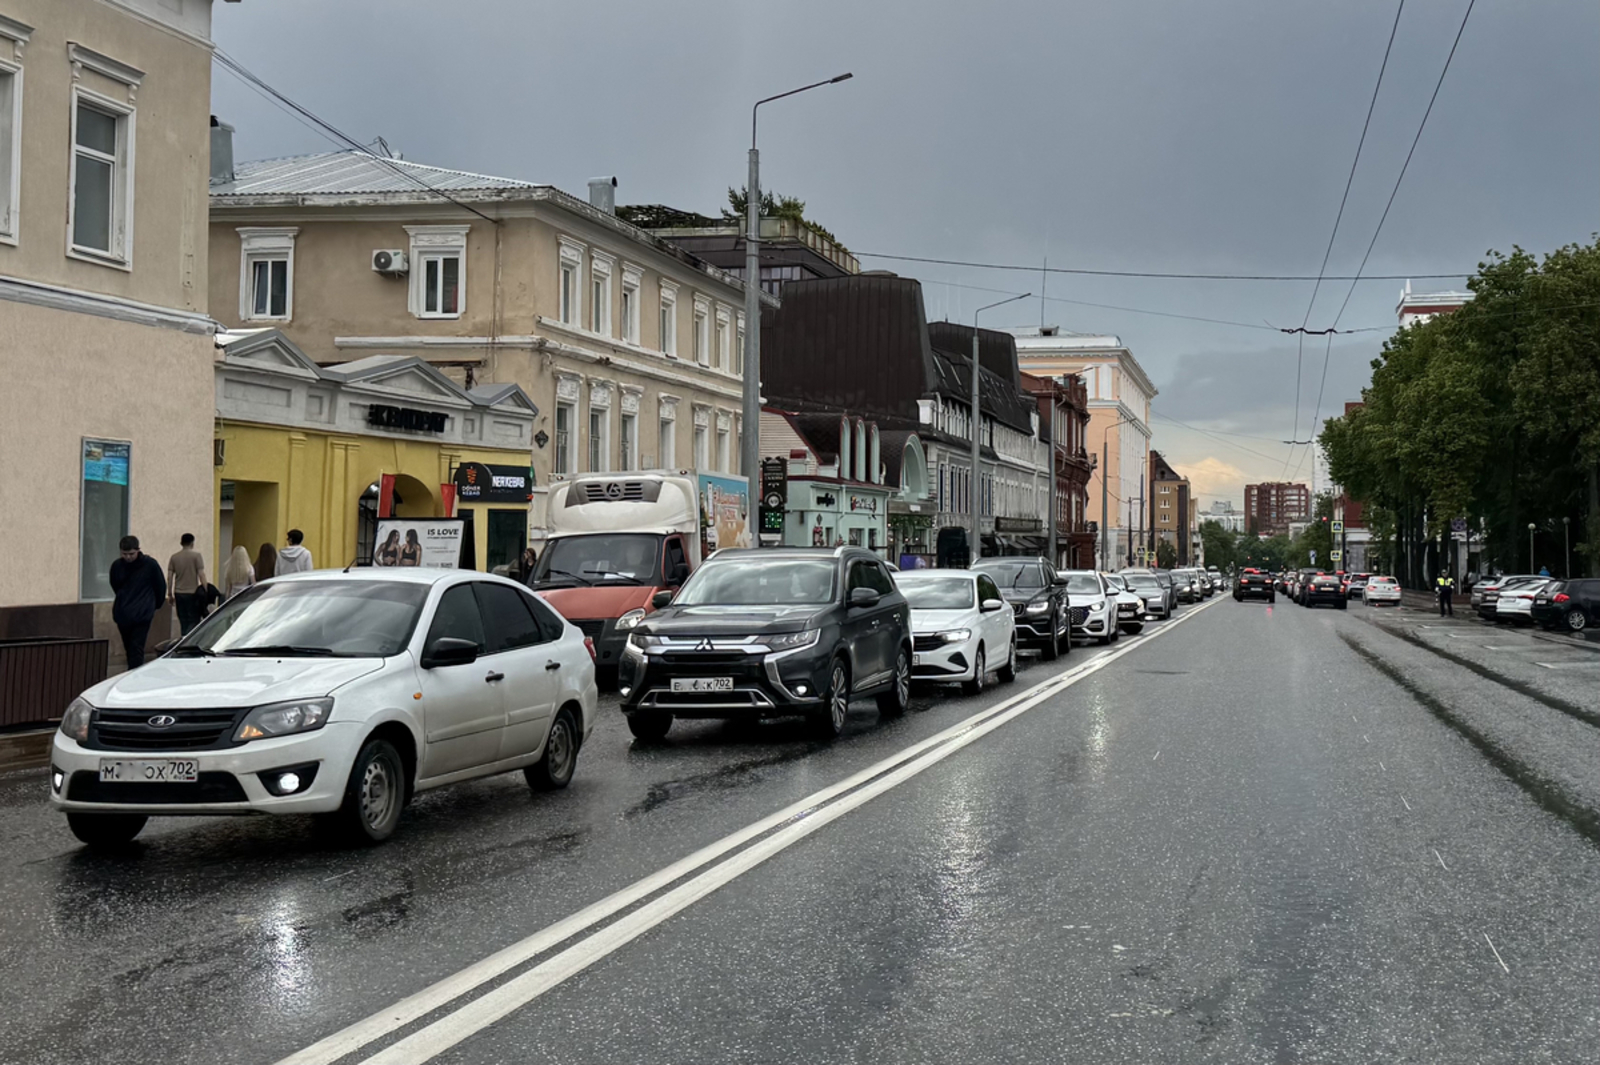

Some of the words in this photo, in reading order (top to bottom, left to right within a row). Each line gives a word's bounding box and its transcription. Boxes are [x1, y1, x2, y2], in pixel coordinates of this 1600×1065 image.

[427, 528, 436, 536] IS
[437, 528, 459, 536] LOVE
[714, 679, 730, 687] 702
[169, 762, 194, 775] 702
